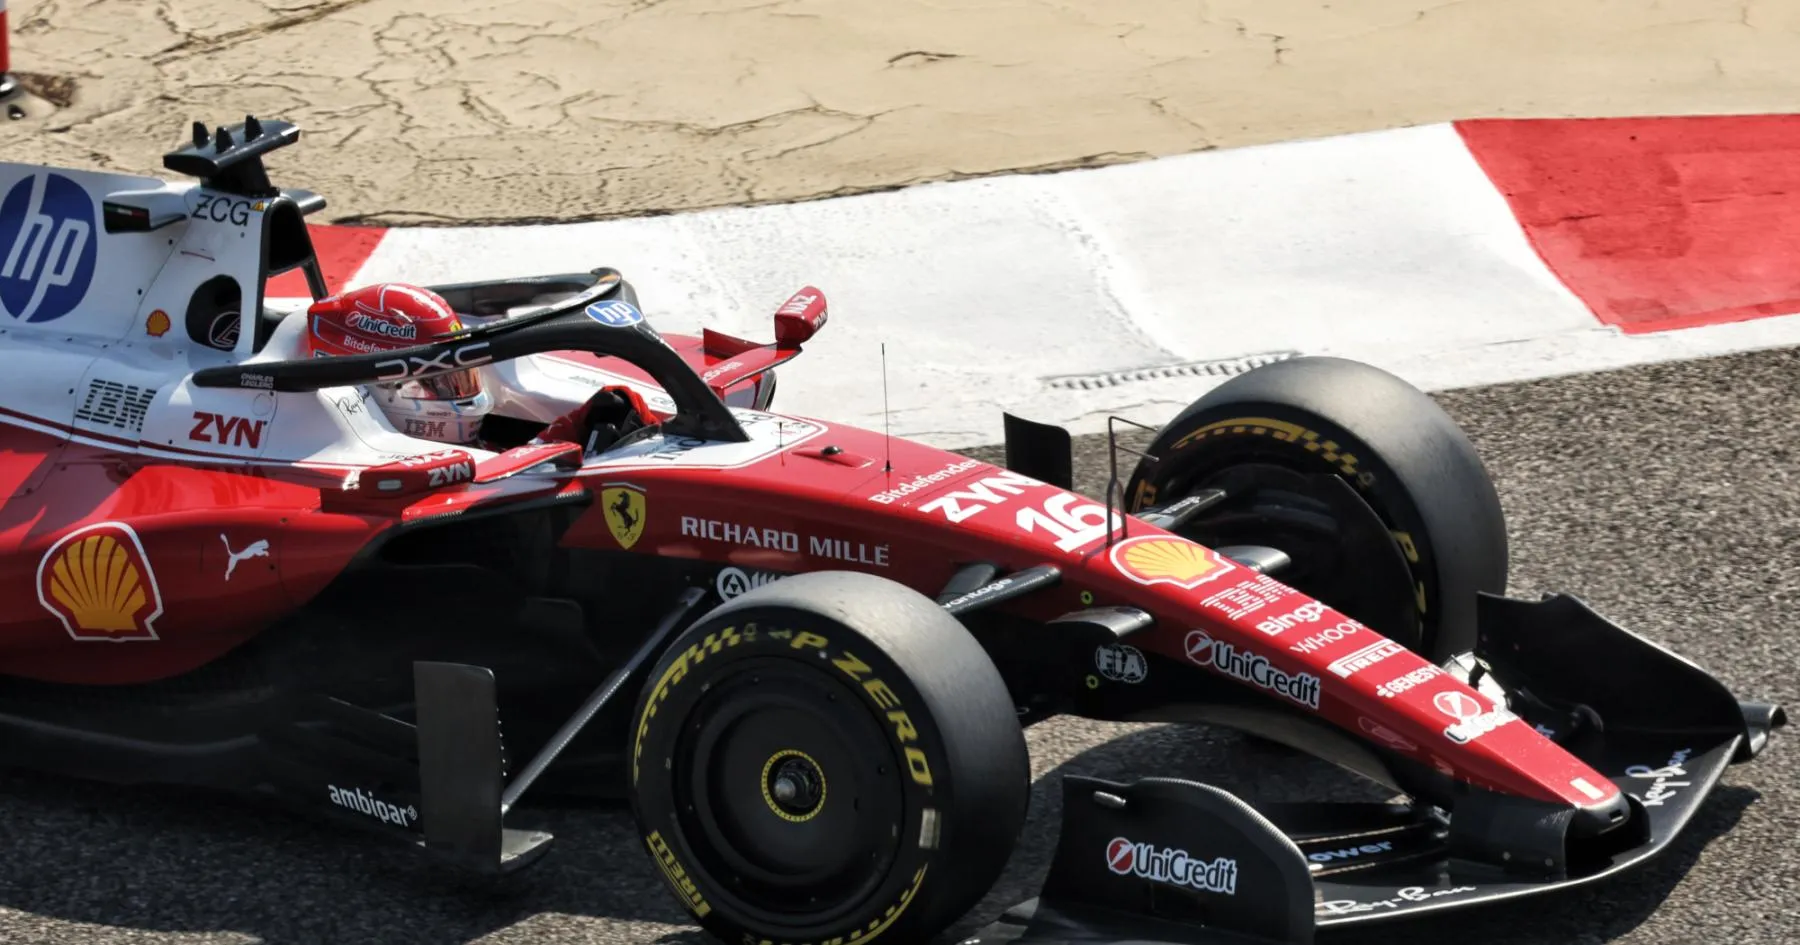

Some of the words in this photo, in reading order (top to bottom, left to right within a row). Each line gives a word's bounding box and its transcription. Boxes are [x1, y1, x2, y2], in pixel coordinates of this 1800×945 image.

[1, 173, 91, 320] hp
[357, 315, 417, 340] UniCredit
[600, 303, 635, 323] hp
[75, 378, 157, 433] IBM
[189, 411, 264, 449] ZYN
[403, 418, 447, 438] IBM
[427, 461, 472, 487] ZYN
[868, 458, 986, 505] Bitdefender
[917, 470, 1046, 524] ZYN
[680, 515, 799, 553] RICHARD
[1016, 492, 1123, 554] 16
[1199, 573, 1299, 621] IBM
[1255, 600, 1332, 636] BingX
[1099, 648, 1143, 679] FIA
[1212, 640, 1321, 709] UniCredit
[1133, 842, 1238, 895] UniCredit
[1323, 886, 1477, 917] Ray-Ban
